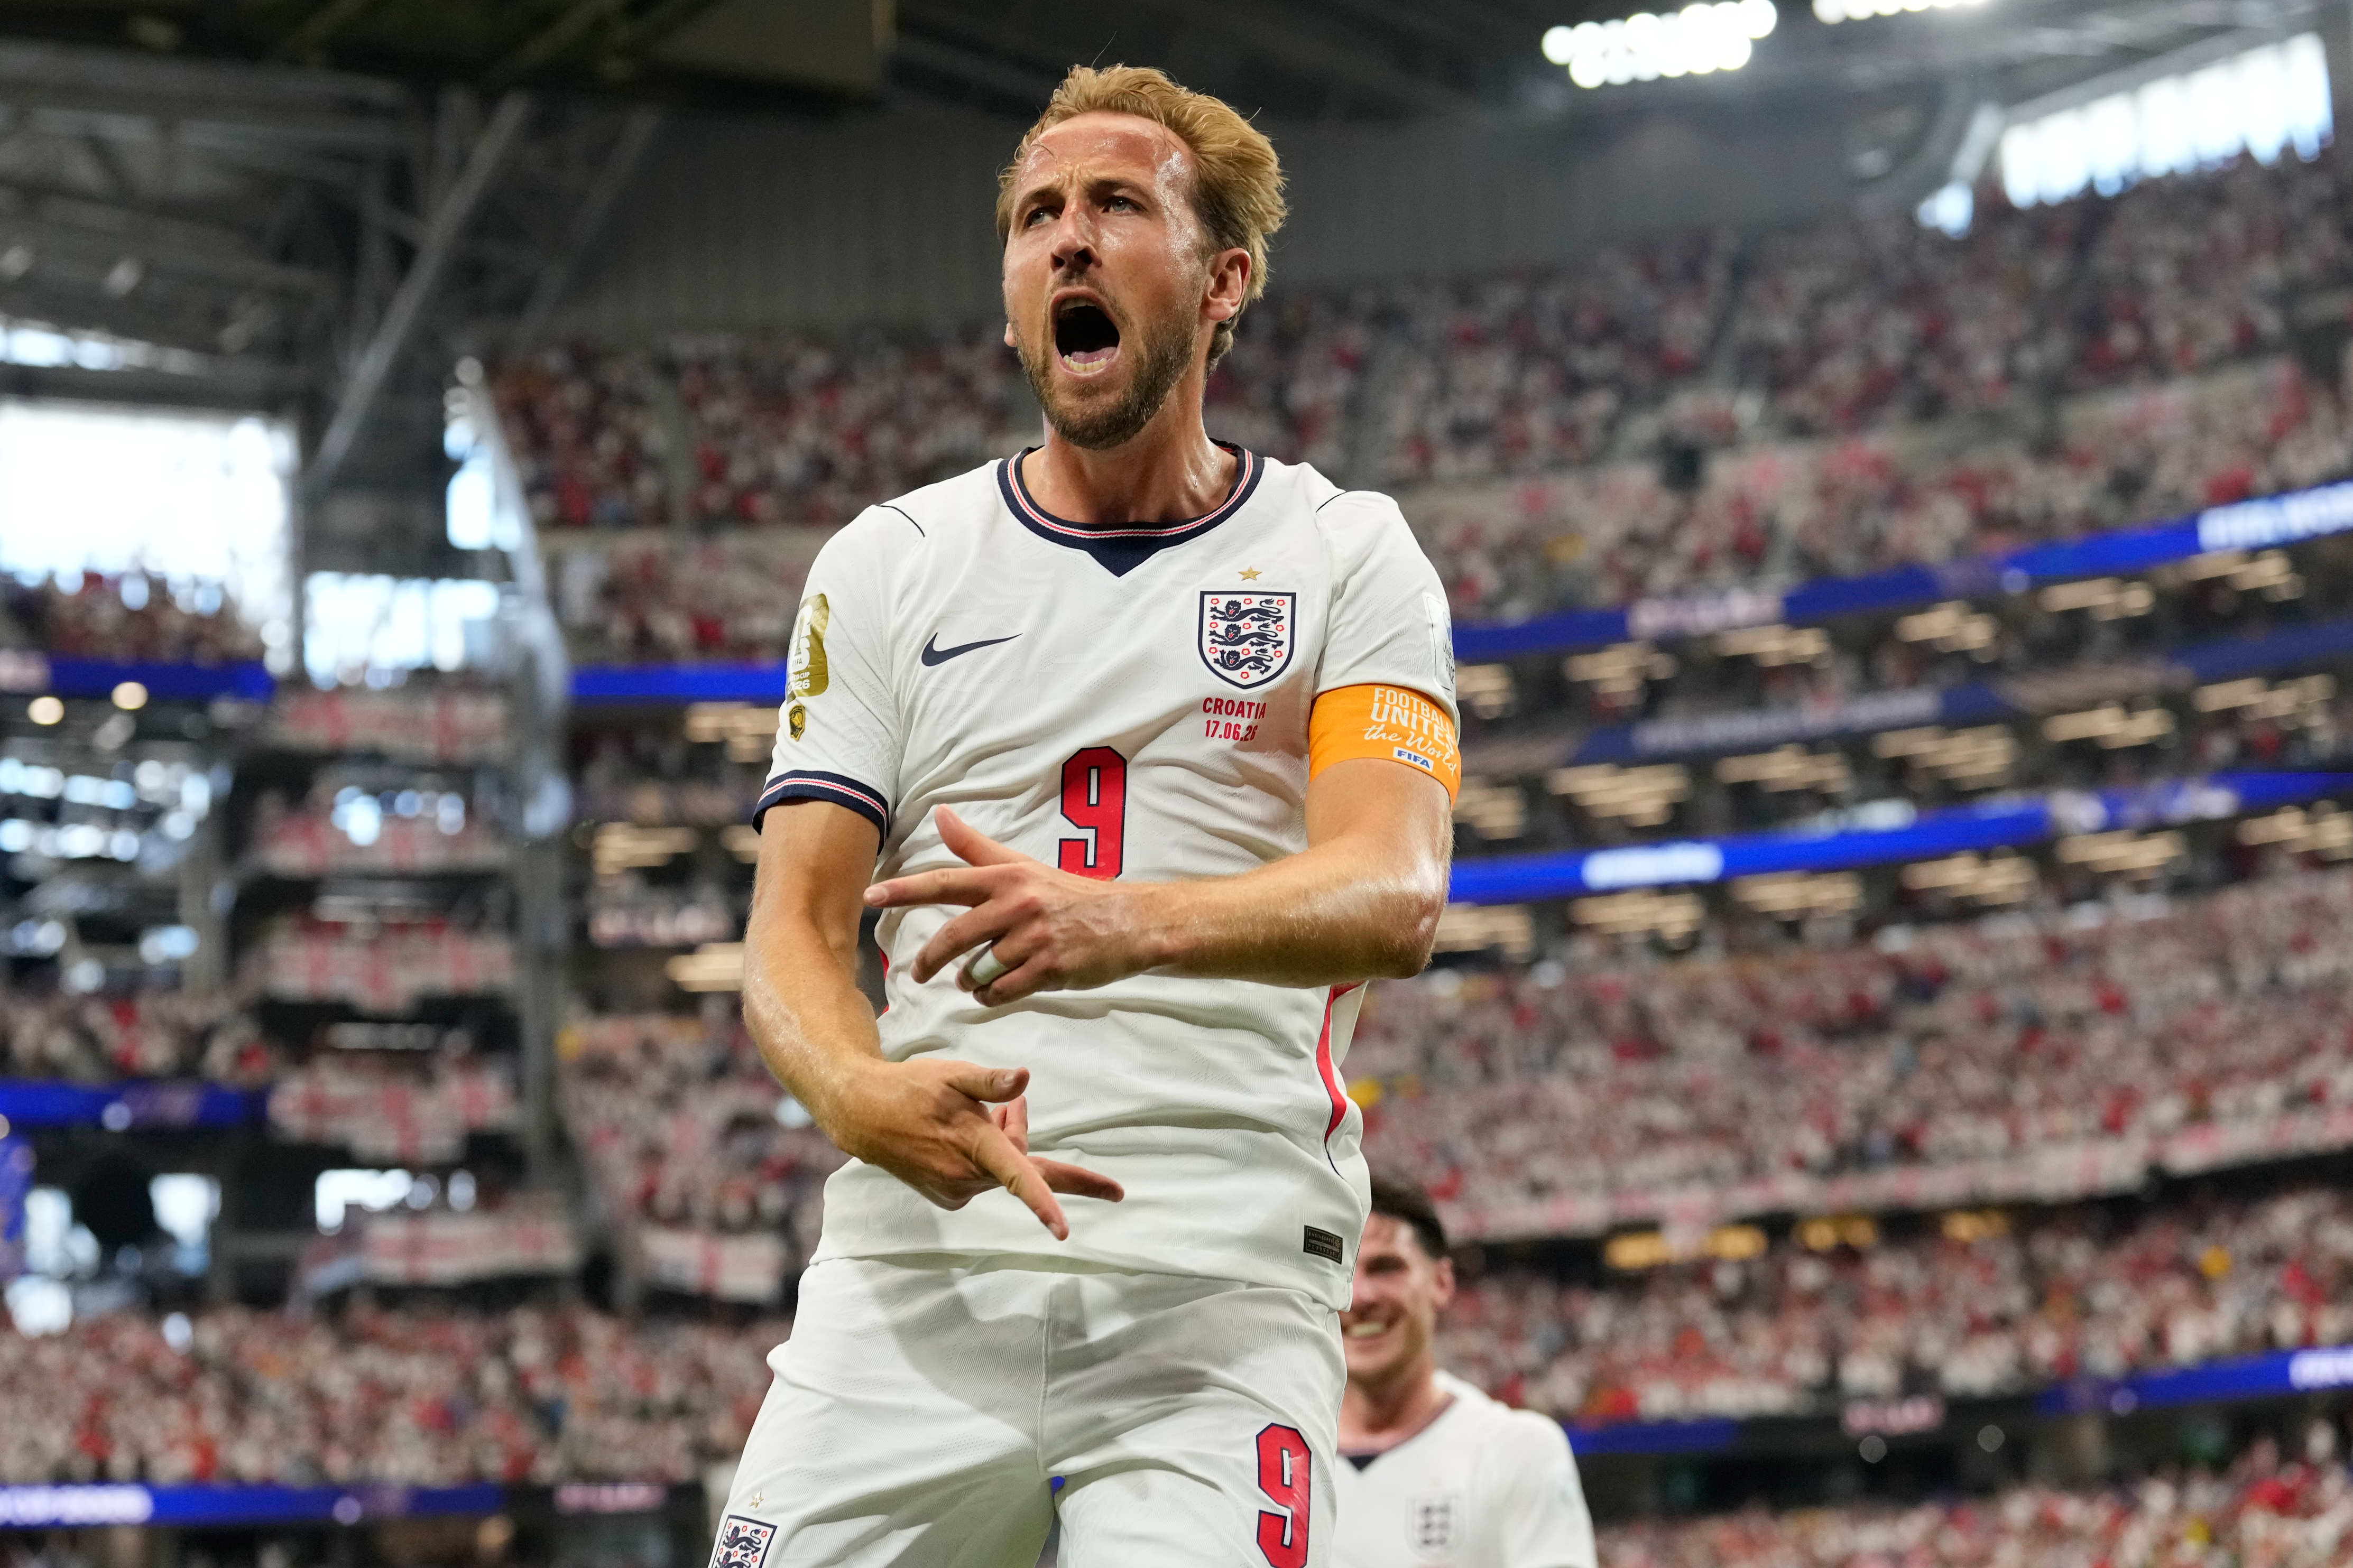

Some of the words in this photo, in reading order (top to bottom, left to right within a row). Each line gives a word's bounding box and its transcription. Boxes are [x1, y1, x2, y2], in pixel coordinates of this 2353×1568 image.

[792, 657, 802, 667] FIFA
[1203, 697, 1267, 719] CROATIA
[1205, 719, 1258, 741] 17.06.26
[1370, 702, 1454, 755] UNITES
[1374, 688, 1453, 738] FOOTBALL
[1363, 725, 1402, 742] the
[1405, 731, 1457, 777] World
[1397, 749, 1431, 771] FIFA
[1058, 746, 1127, 882] 9
[1256, 1422, 1312, 1568] 9
